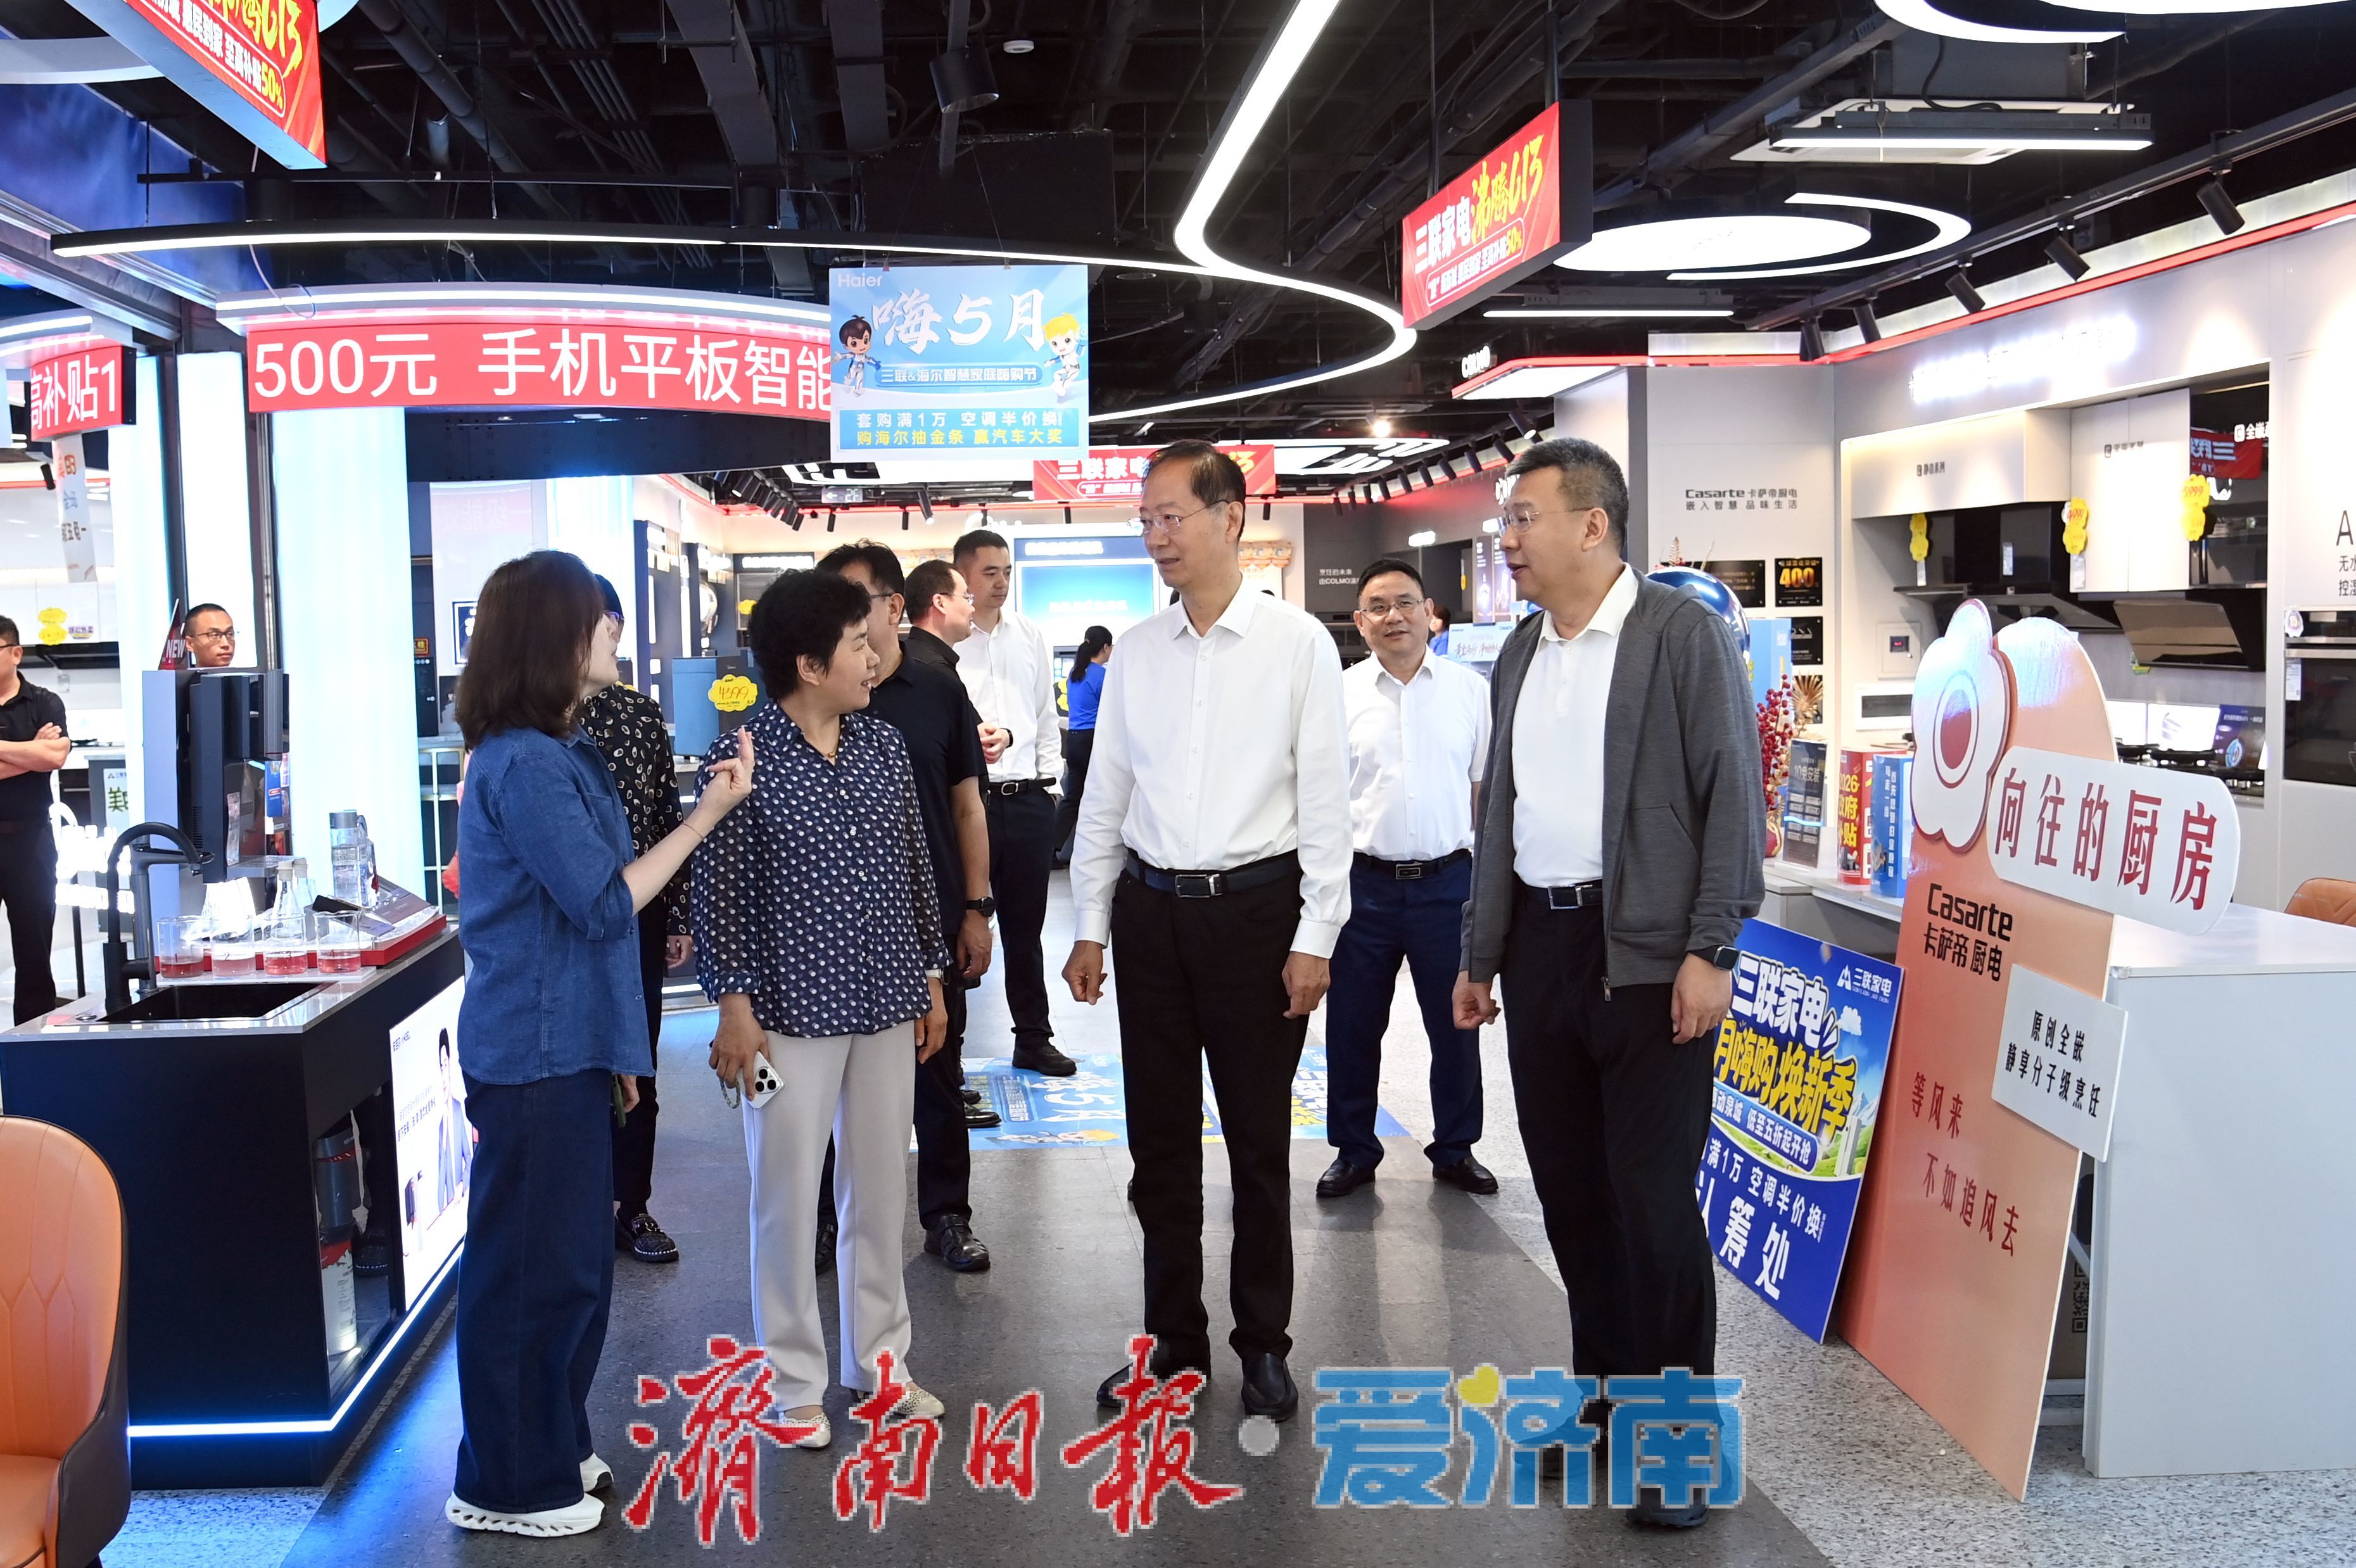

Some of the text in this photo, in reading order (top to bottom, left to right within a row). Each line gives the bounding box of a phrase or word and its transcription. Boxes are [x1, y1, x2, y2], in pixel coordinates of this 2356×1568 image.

[837, 274, 882, 287] Haier
[255, 327, 830, 411] 500元 手机平板智能
[856, 412, 947, 428] 套购满1万
[856, 428, 1063, 446] 购海尔抽金条 赢汽车大奖
[1685, 488, 1797, 499] Casarte 卡萨帝厨电
[1745, 500, 1797, 510] 品味生活
[166, 639, 186, 659] NEW
[1995, 768, 2217, 910] 向往的厨房
[1927, 883, 2013, 942] Casarte
[1732, 956, 1827, 1049] 三联家电
[1852, 968, 1892, 997] 三联家电
[2030, 1010, 2085, 1063] 原创全嵌
[1910, 1072, 1964, 1139] 等风来
[2005, 1042, 2101, 1118] 静享分子级烹饪
[1746, 1108, 1811, 1165] 低至五折起开抢
[1923, 1153, 2020, 1257] 不如追风去
